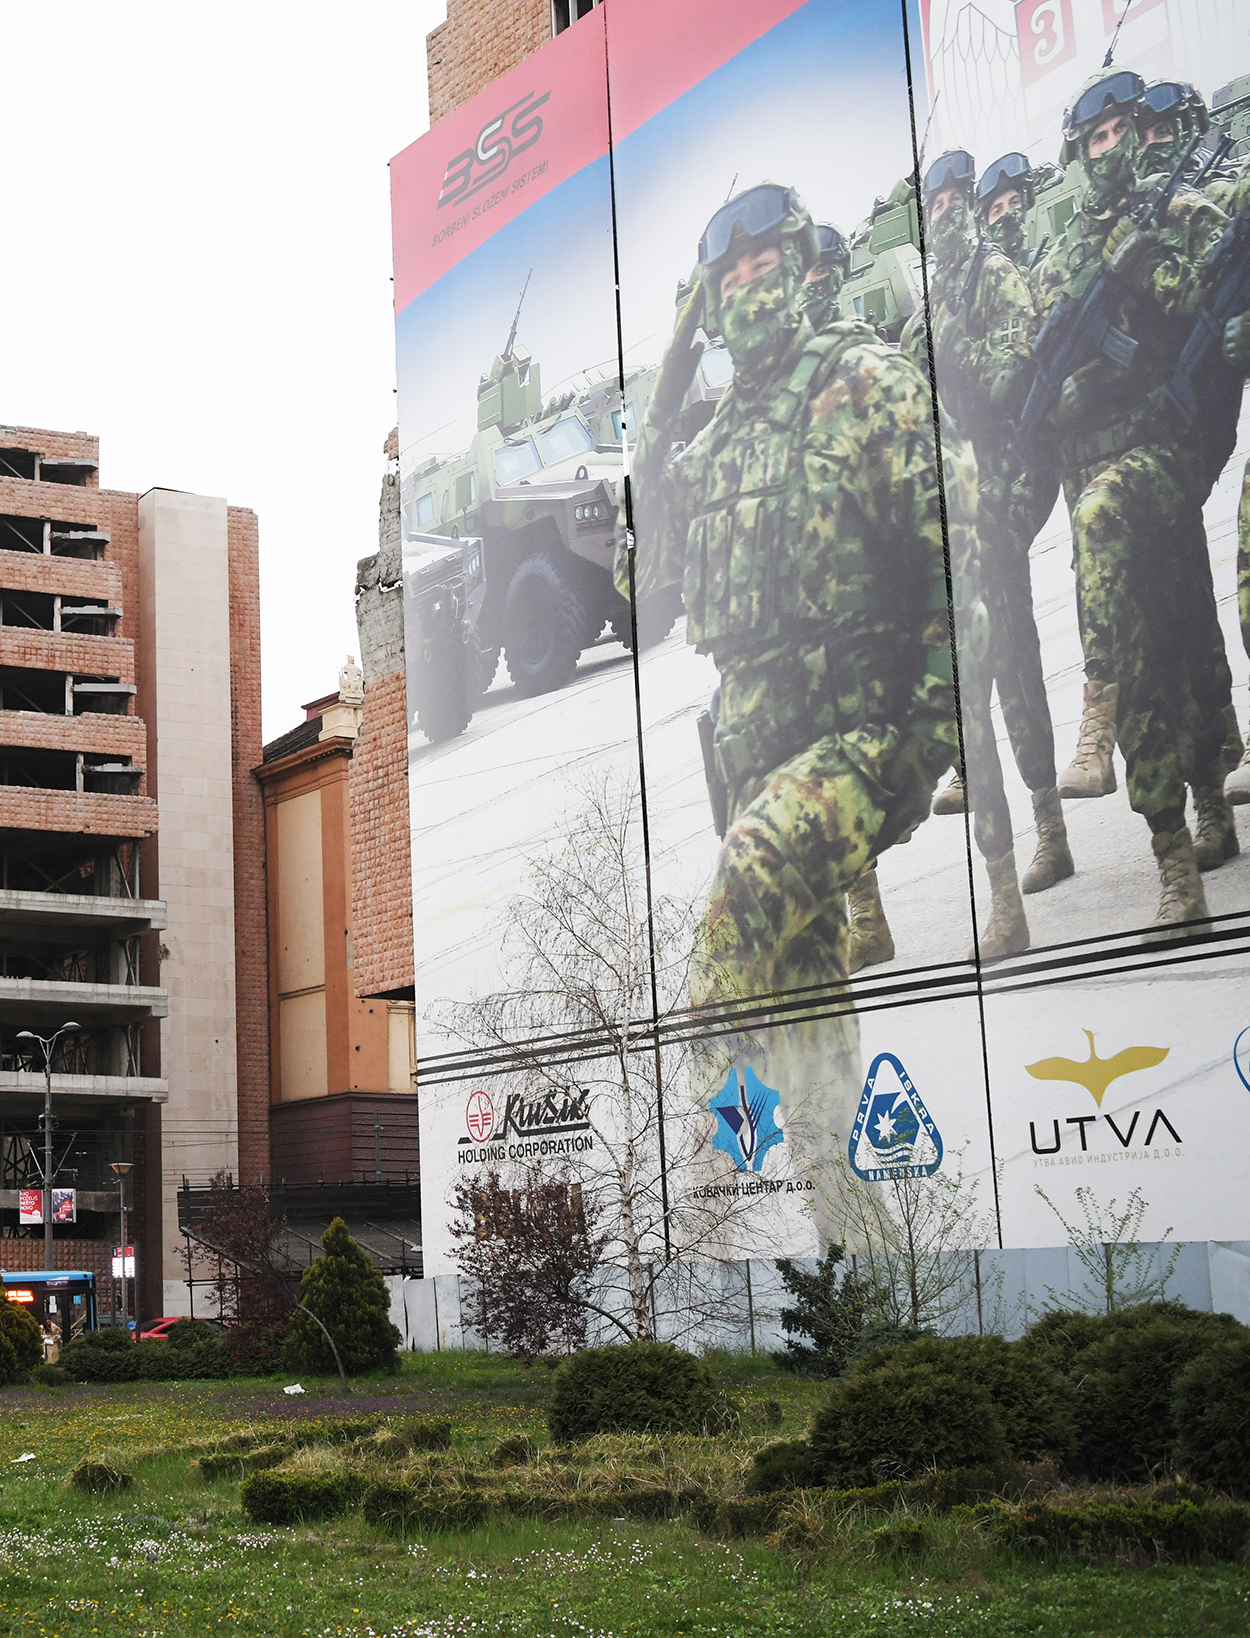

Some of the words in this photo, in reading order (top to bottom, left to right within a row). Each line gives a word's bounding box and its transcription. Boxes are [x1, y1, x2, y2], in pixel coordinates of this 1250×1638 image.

[432, 211, 471, 247] BORBENI
[471, 186, 510, 221] SLOŽENI
[511, 159, 549, 194] SISTEMI
[852, 1077, 875, 1141] PRVA
[899, 1071, 935, 1134] ISKRA
[458, 1146, 506, 1164] HOLDING
[508, 1135, 593, 1159] CORPORATION
[1029, 1109, 1183, 1155] UTVA
[1033, 1157, 1056, 1168] УТВА
[1059, 1155, 1083, 1166] АВИО
[1087, 1151, 1150, 1164] ИНДУСТРИЈА
[741, 1180, 783, 1197] ЦЕНТАР
